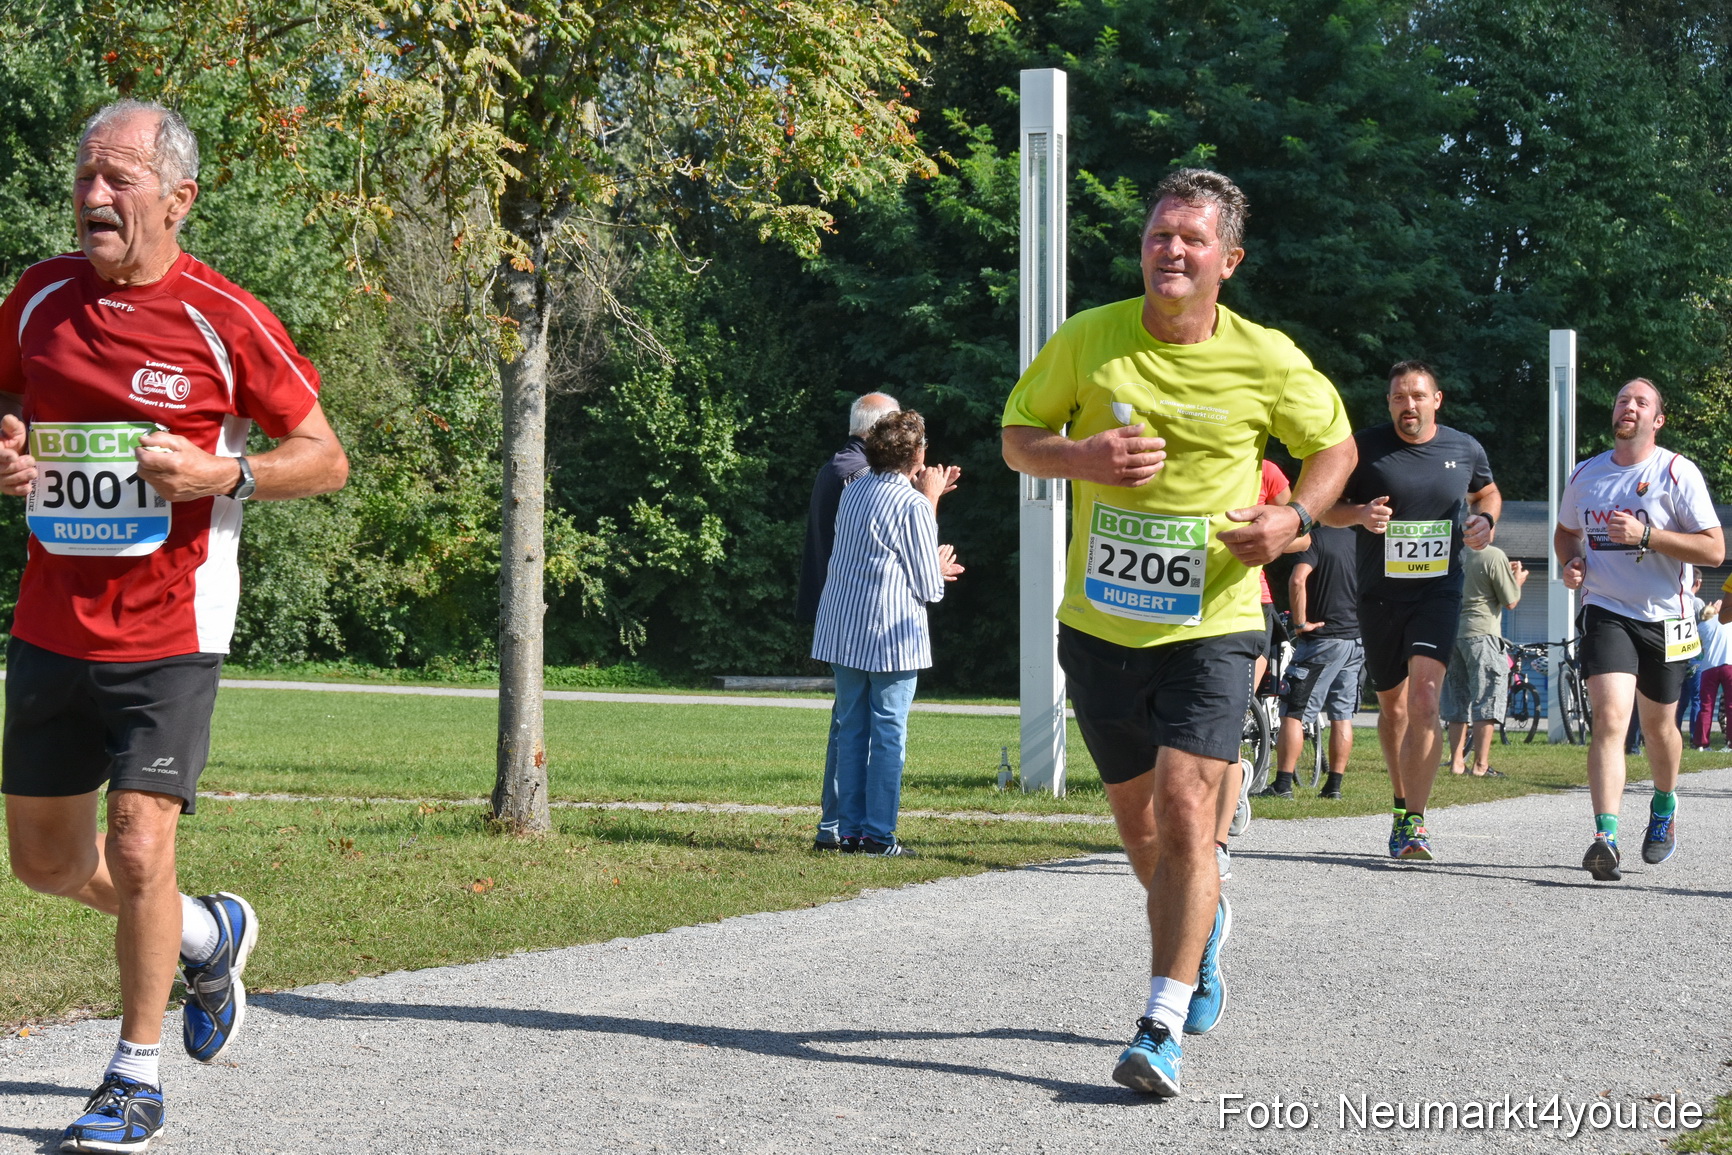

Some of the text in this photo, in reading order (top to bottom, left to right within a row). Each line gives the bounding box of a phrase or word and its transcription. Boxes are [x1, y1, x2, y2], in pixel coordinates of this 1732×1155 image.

[98, 298, 127, 310] CRAFT
[145, 360, 183, 373] Laufteam
[128, 393, 158, 406] Kraftsport
[1159, 399, 1185, 408] Kliniken
[1196, 404, 1230, 415] Landkreises
[1176, 408, 1206, 418] Neumarkt
[37, 429, 151, 458] BOCK
[43, 469, 147, 509] 3001
[53, 523, 139, 540] RUDOLF
[1097, 509, 1197, 546] BOCK
[1391, 523, 1447, 536] BOCK
[1394, 541, 1444, 559] 1212
[1098, 543, 1191, 587] 2206
[1103, 587, 1177, 611] HUBERT
[134, 1048, 159, 1057] SOCKS
